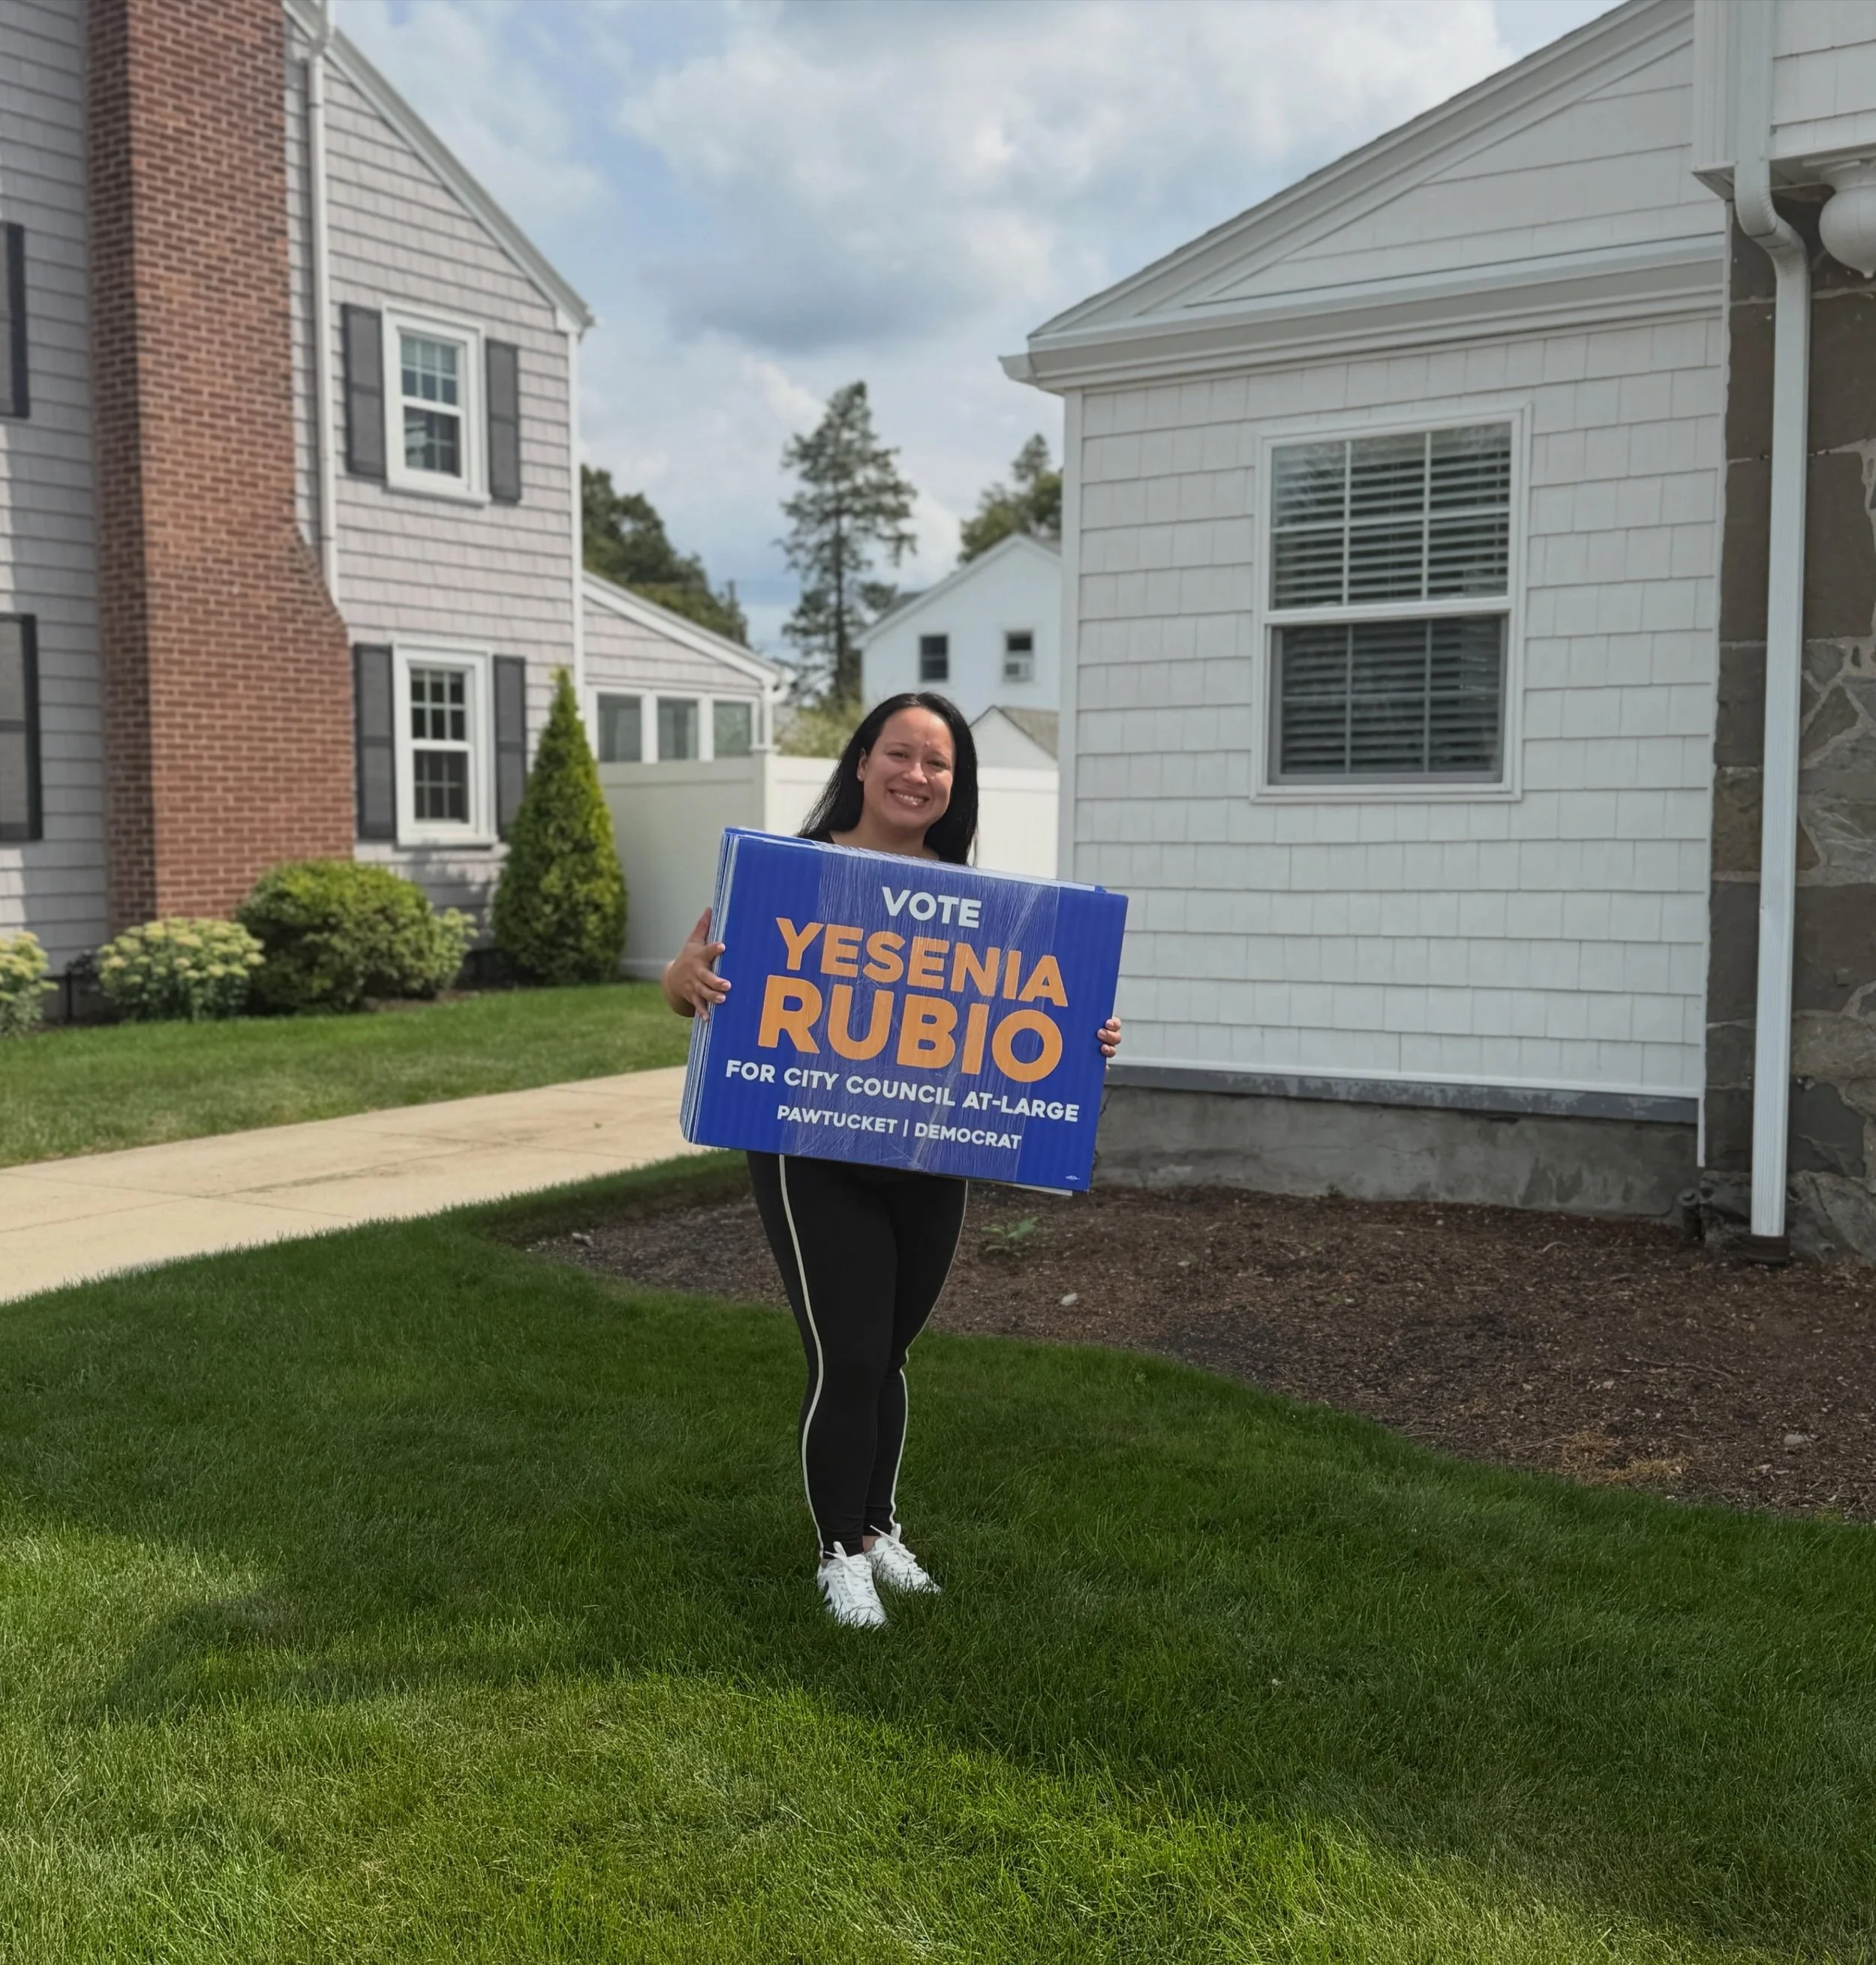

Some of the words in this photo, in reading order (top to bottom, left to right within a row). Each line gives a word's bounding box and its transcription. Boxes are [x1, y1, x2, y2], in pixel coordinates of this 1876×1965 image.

[882, 886, 982, 928] VOTE
[775, 917, 1069, 1008] YESENIA
[757, 975, 1063, 1083] RUBIO
[726, 1059, 775, 1083] FOR
[783, 1068, 839, 1091] CITY
[846, 1075, 955, 1107] COUNCIL
[963, 1090, 1080, 1122] AT-LARGE
[777, 1105, 897, 1134] PAWTUCKET
[914, 1123, 1022, 1150] DEMOCRAT
